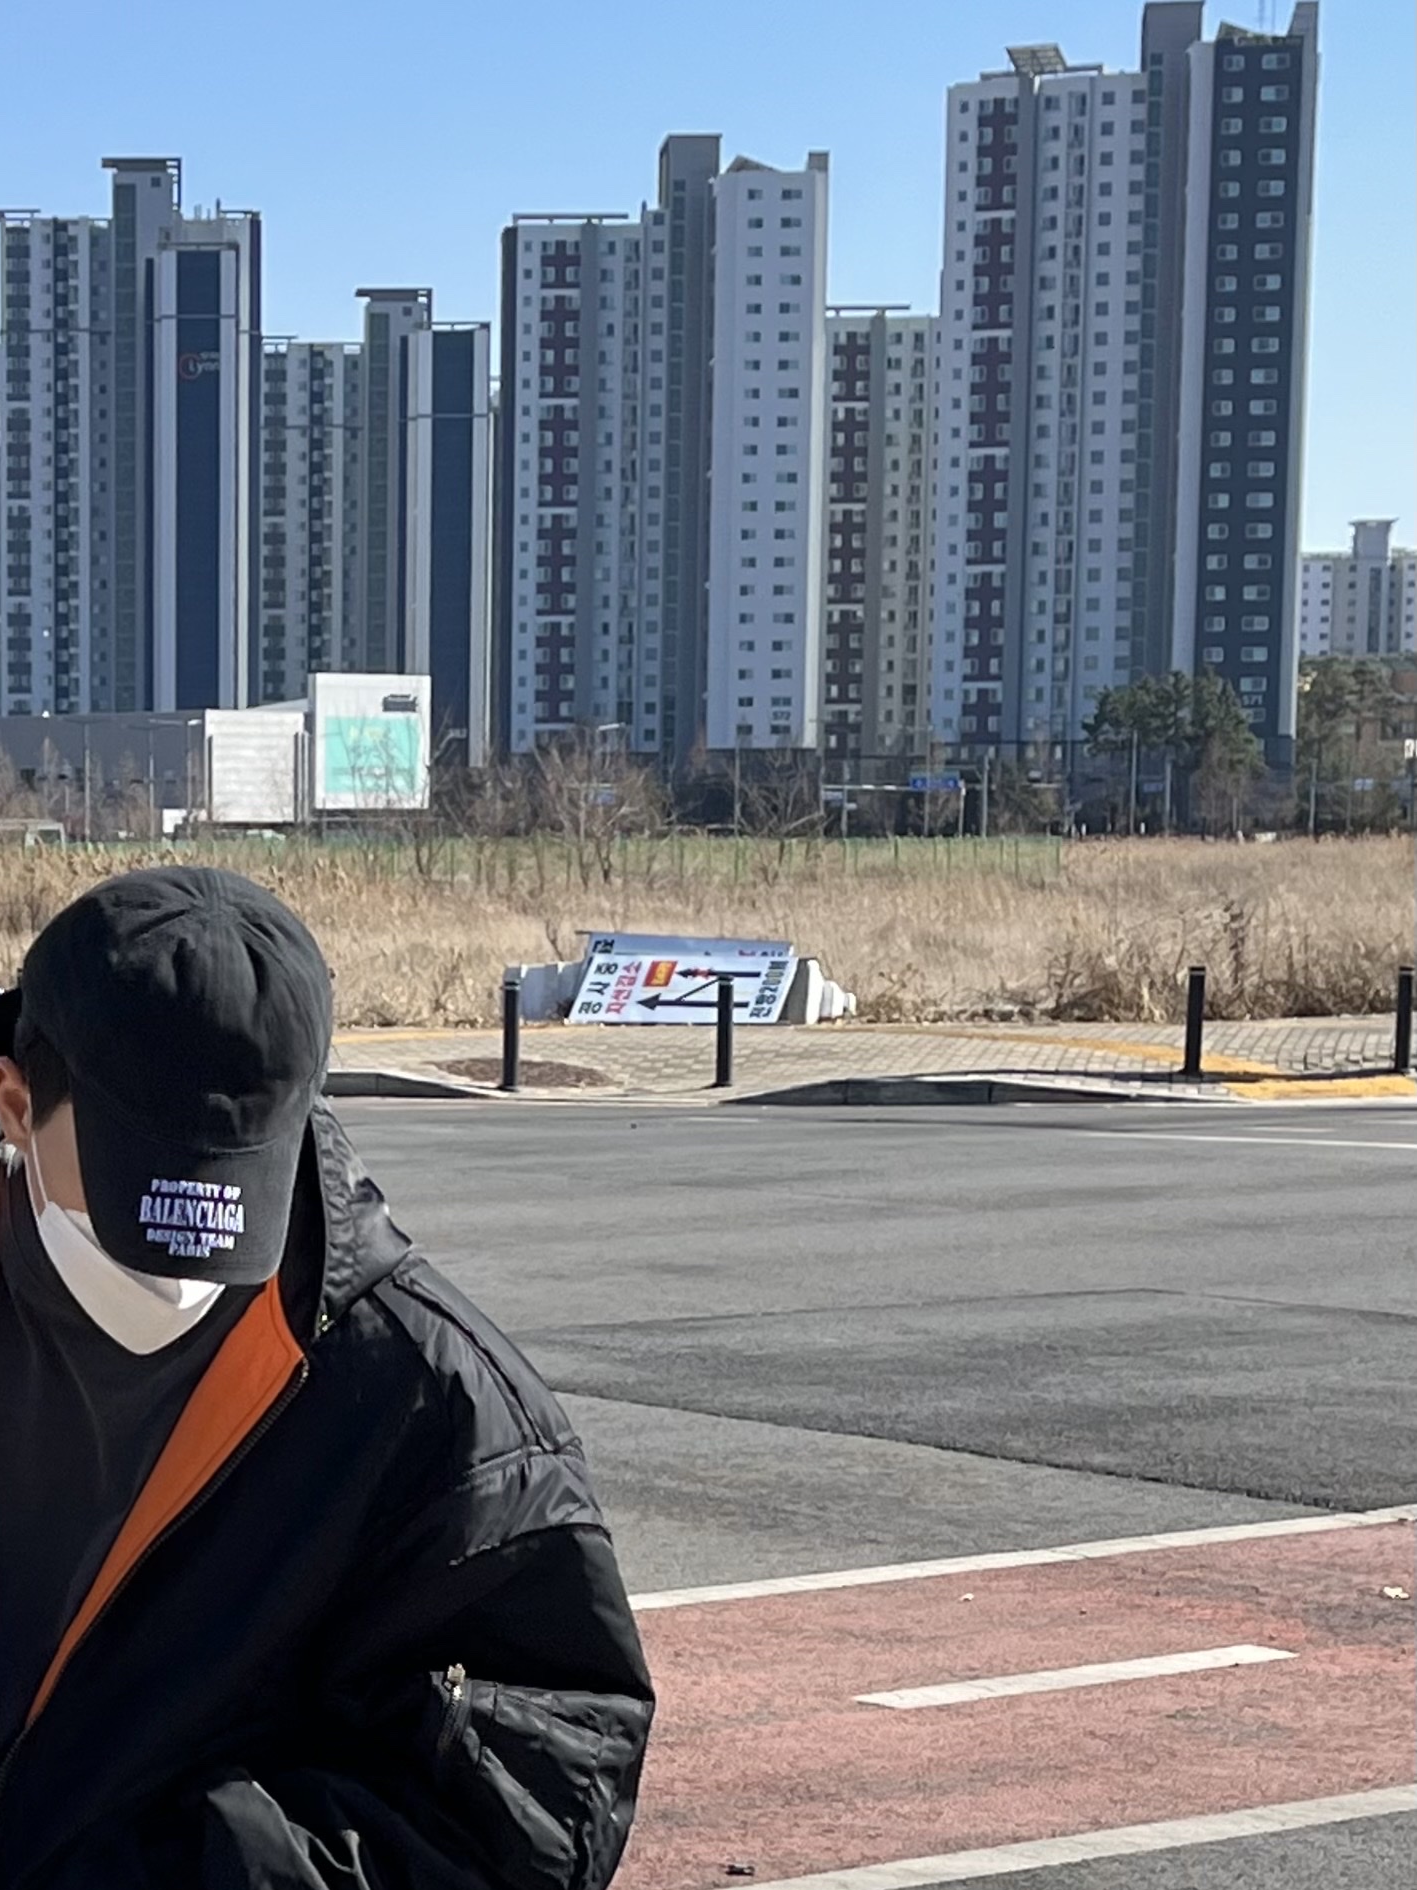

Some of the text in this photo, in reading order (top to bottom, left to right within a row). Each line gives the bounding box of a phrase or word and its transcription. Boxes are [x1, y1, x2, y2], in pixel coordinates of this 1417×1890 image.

[151, 1178, 222, 1198] PROPERTY
[139, 1195, 244, 1234] BALENCIAGA
[168, 1242, 211, 1258] PARIS
[199, 1232, 236, 1250] TEAM
